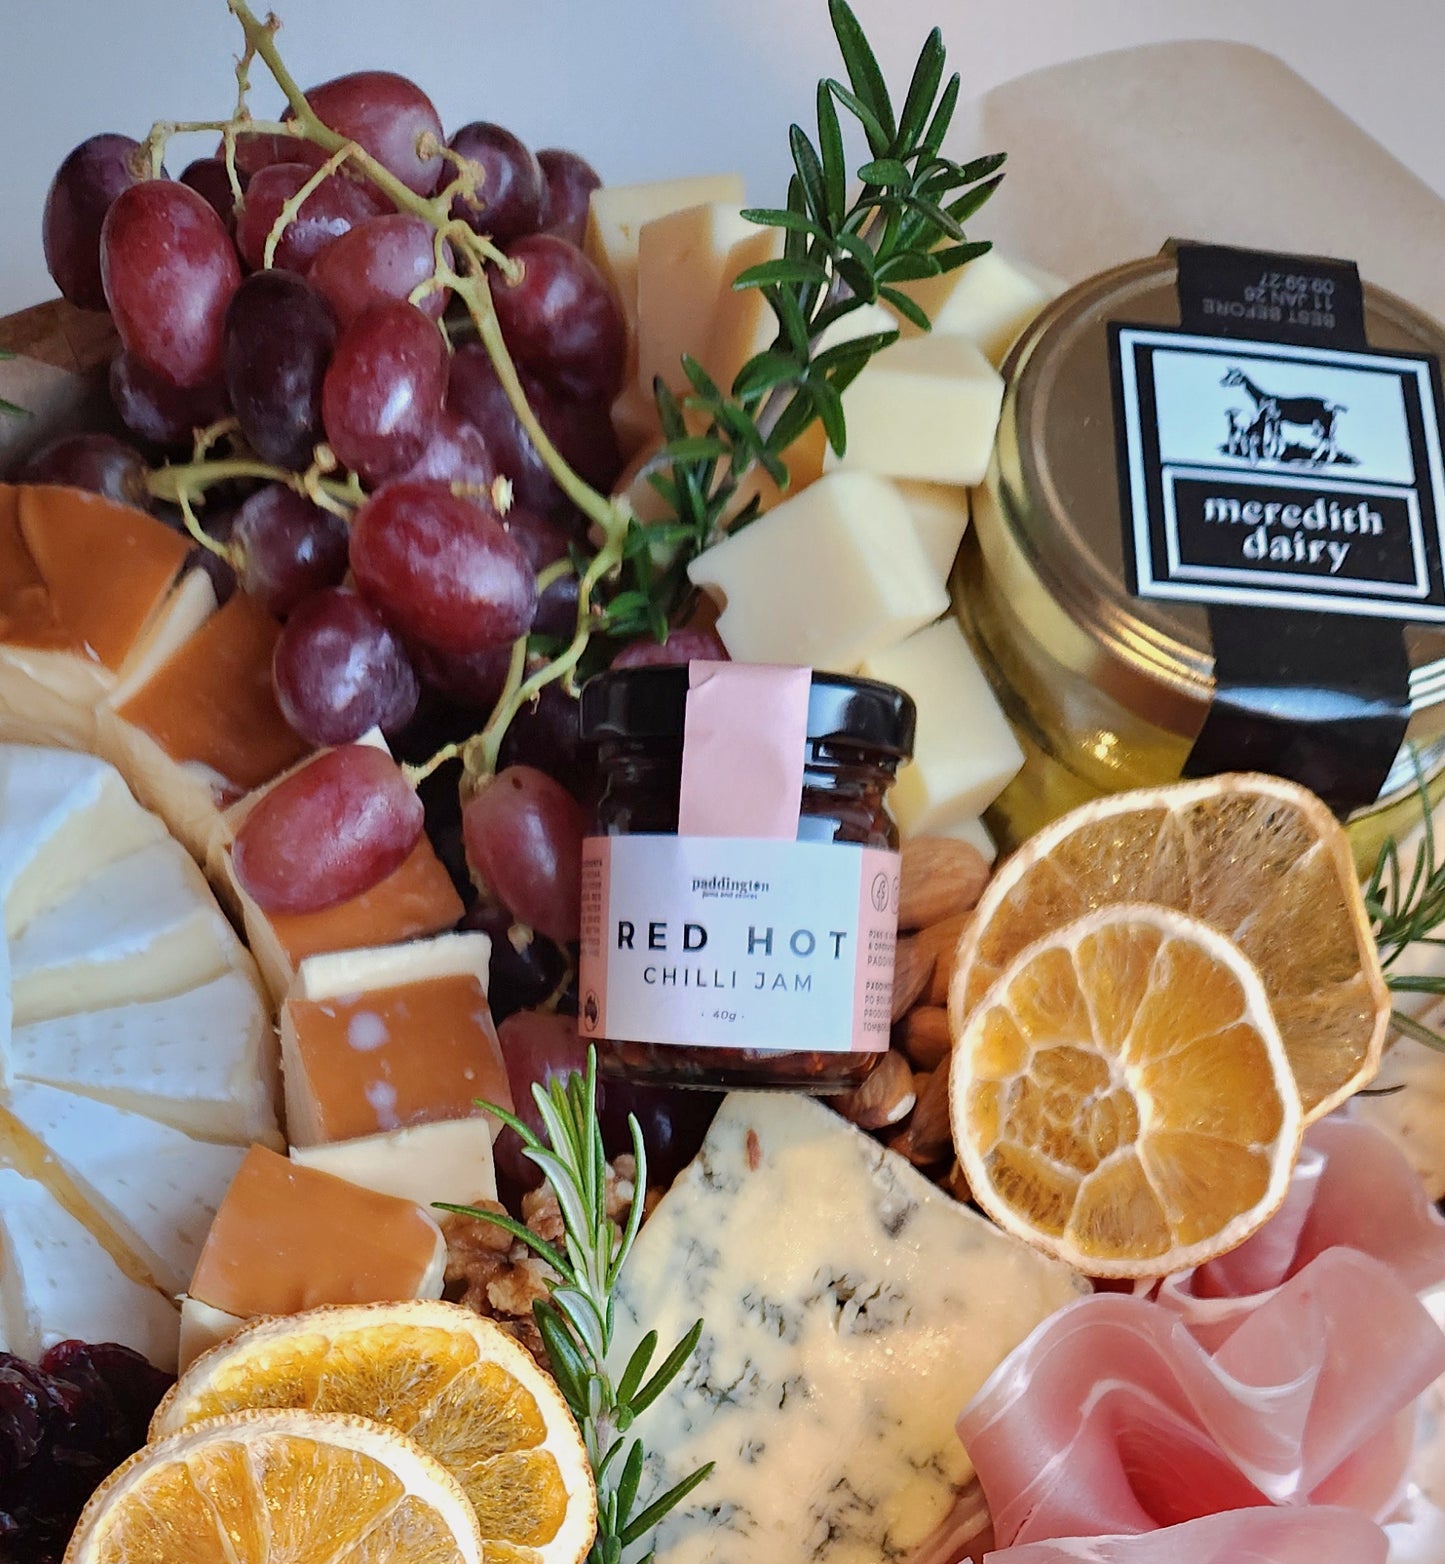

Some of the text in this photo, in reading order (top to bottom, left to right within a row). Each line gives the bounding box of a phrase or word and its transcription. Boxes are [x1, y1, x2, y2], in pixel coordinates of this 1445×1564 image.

[1202, 297, 1336, 329] BEST BEFORE
[1271, 290, 1308, 308] JAN
[1203, 497, 1384, 536] meredith
[1242, 525, 1351, 575] dairy
[692, 875, 769, 894] paddington
[617, 920, 848, 960] RED HOT
[643, 966, 813, 993] CHILLI JAM
[712, 1009, 737, 1022] 40g
